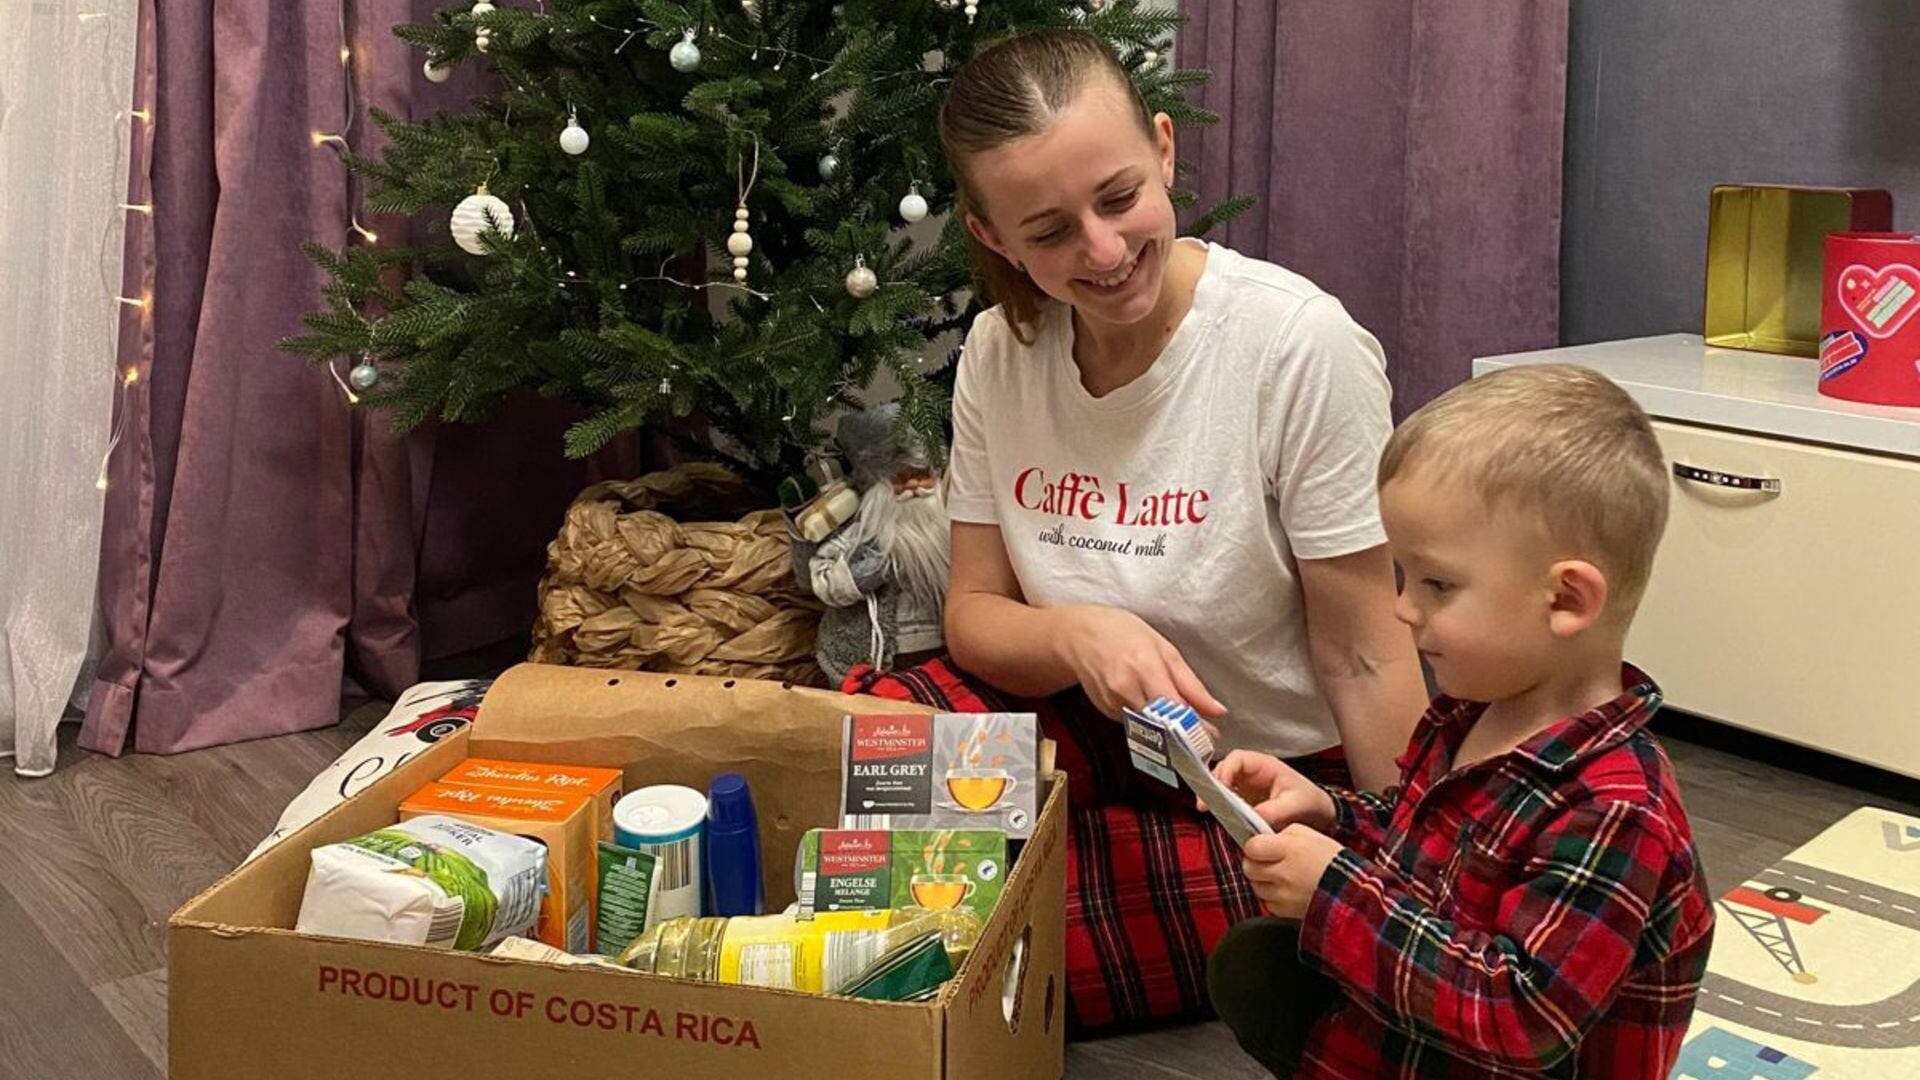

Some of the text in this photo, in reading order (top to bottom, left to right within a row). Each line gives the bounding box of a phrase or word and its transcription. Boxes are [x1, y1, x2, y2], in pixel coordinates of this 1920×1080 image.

[1014, 467, 1209, 527] Caffè Latte
[1039, 523, 1166, 557] with coconut milk
[856, 738, 926, 747] WESTMINSTER
[853, 763, 927, 776] EARL GREY
[830, 878, 877, 888] ENGELSE
[319, 965, 761, 1049] PRODUCT OF COSTA RICA
